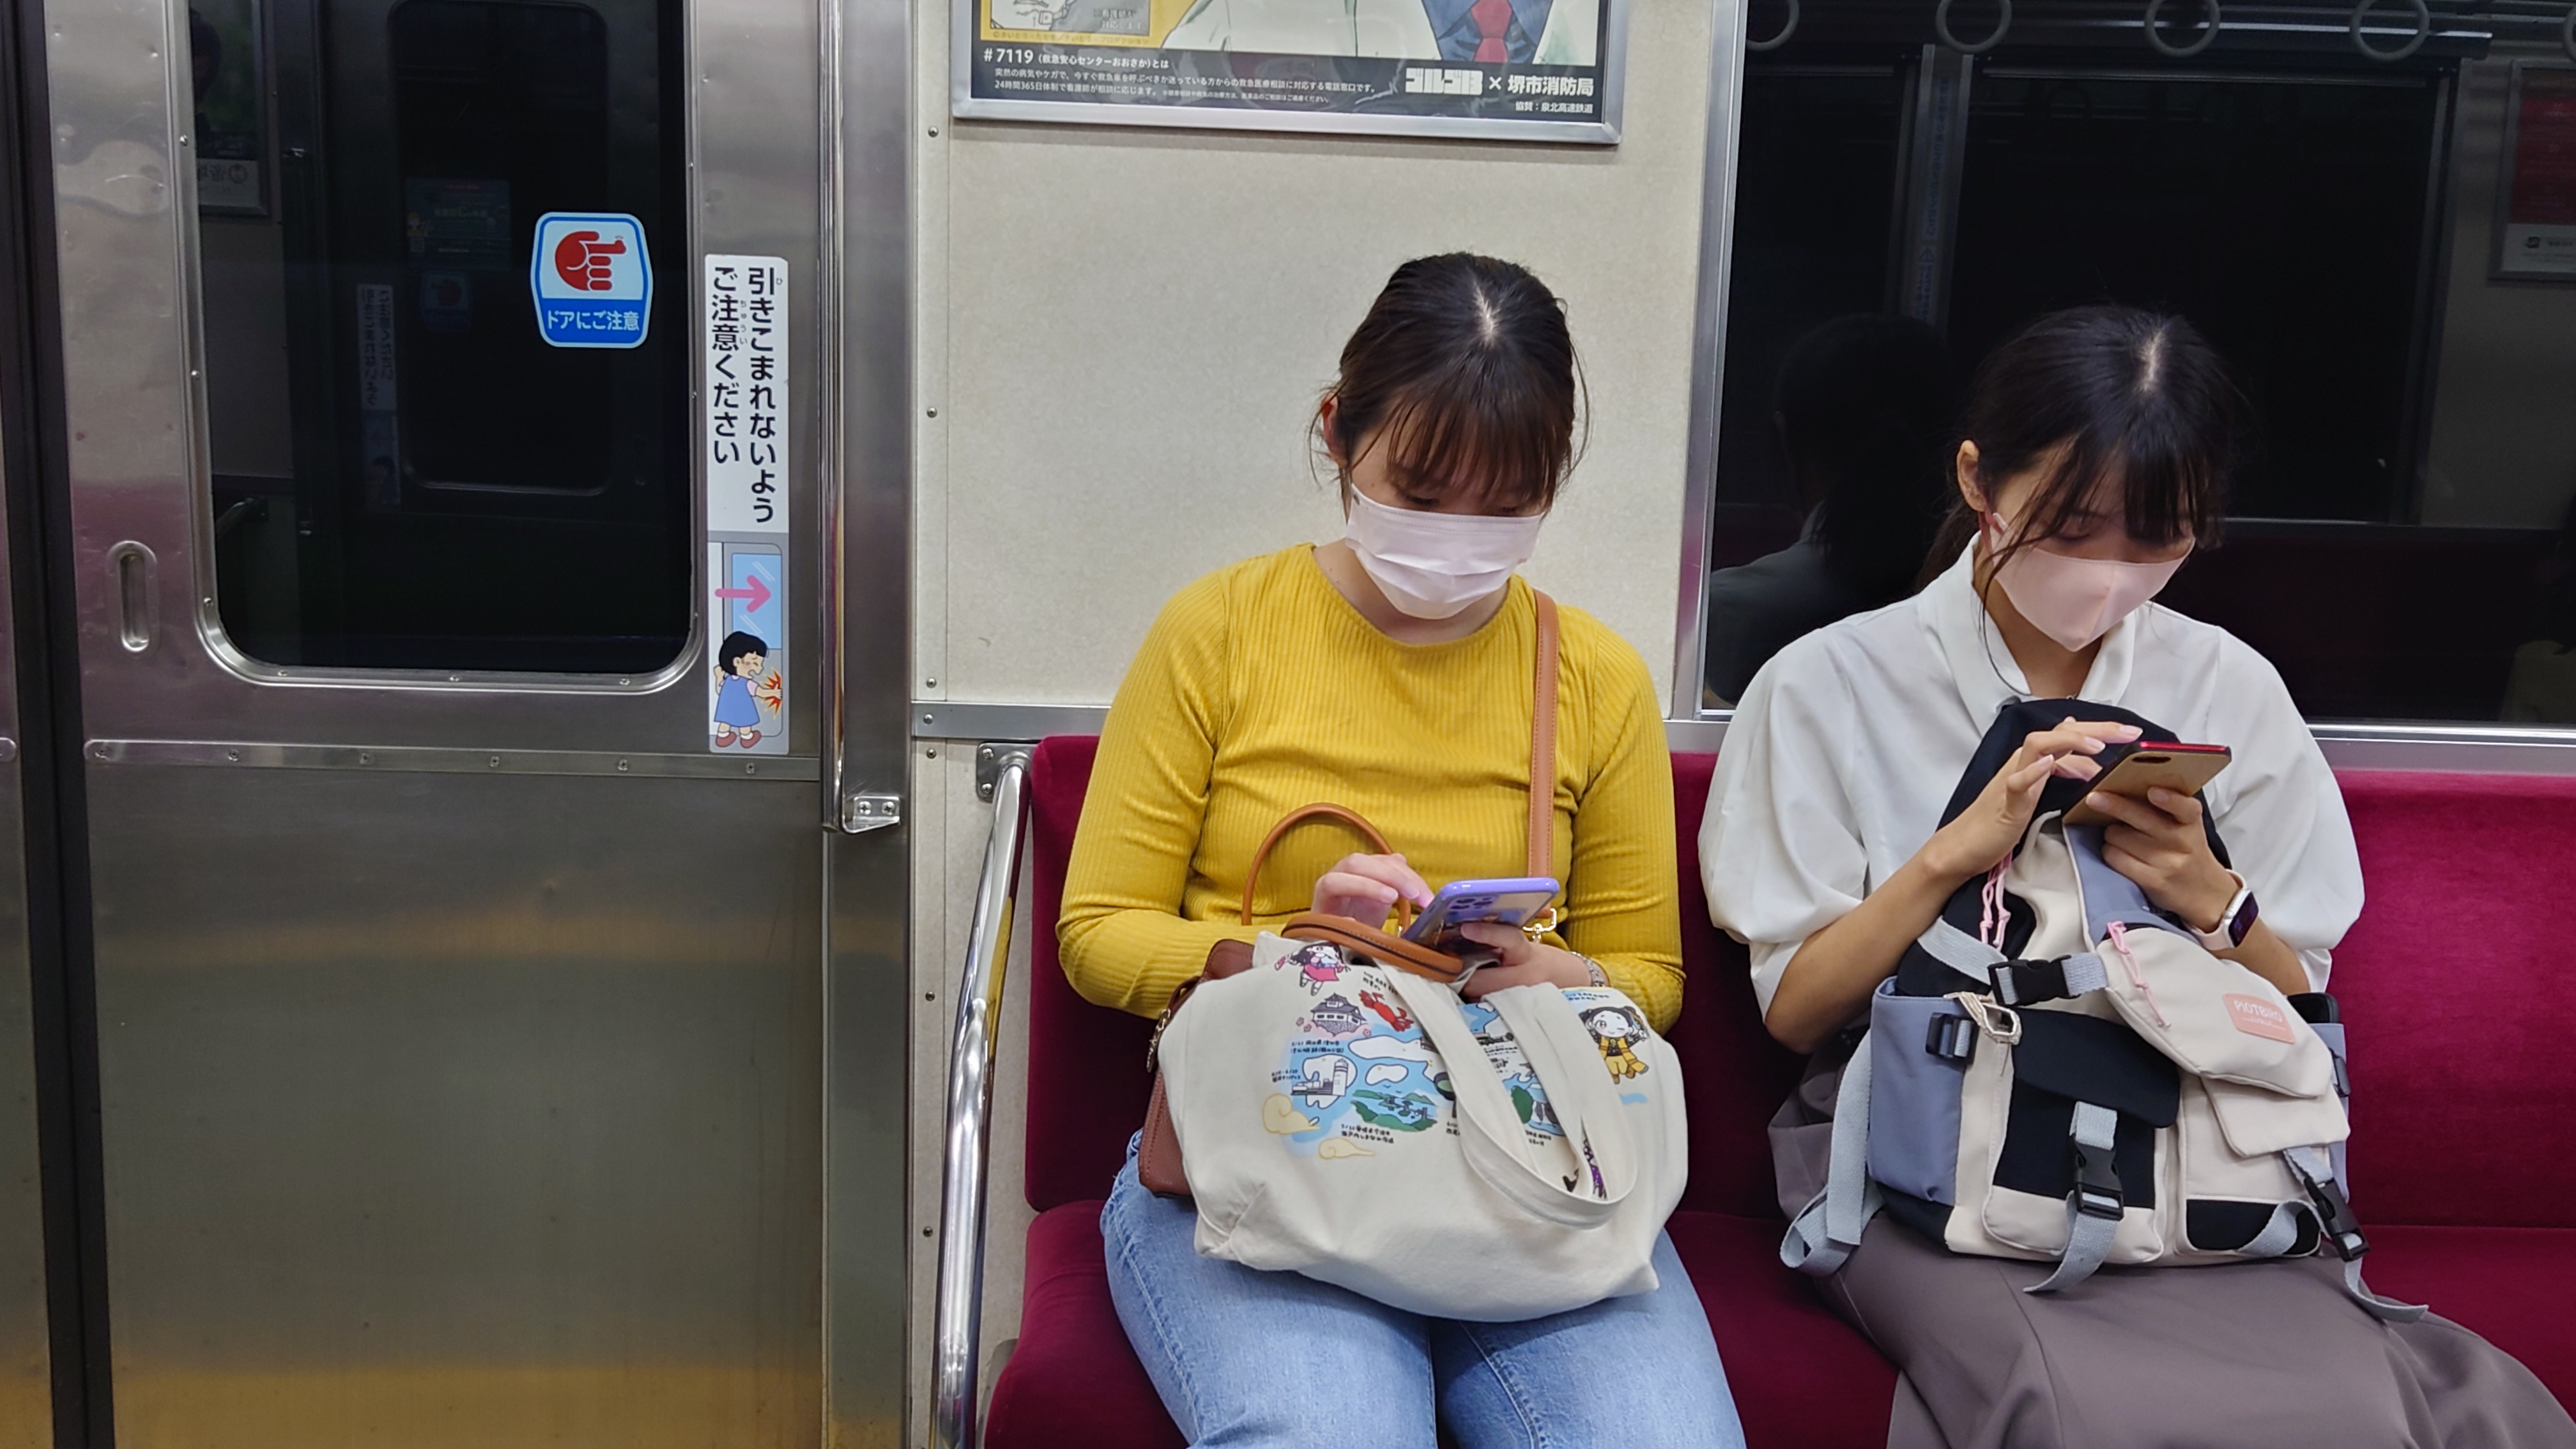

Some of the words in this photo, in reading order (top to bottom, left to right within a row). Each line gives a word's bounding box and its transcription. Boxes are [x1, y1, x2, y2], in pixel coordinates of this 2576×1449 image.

[1508, 75, 1594, 96] 堺市消防局
[548, 310, 640, 330] ドアにご注意
[711, 266, 740, 464] ご注意ください
[748, 266, 776, 523] 引きこまれないよう
